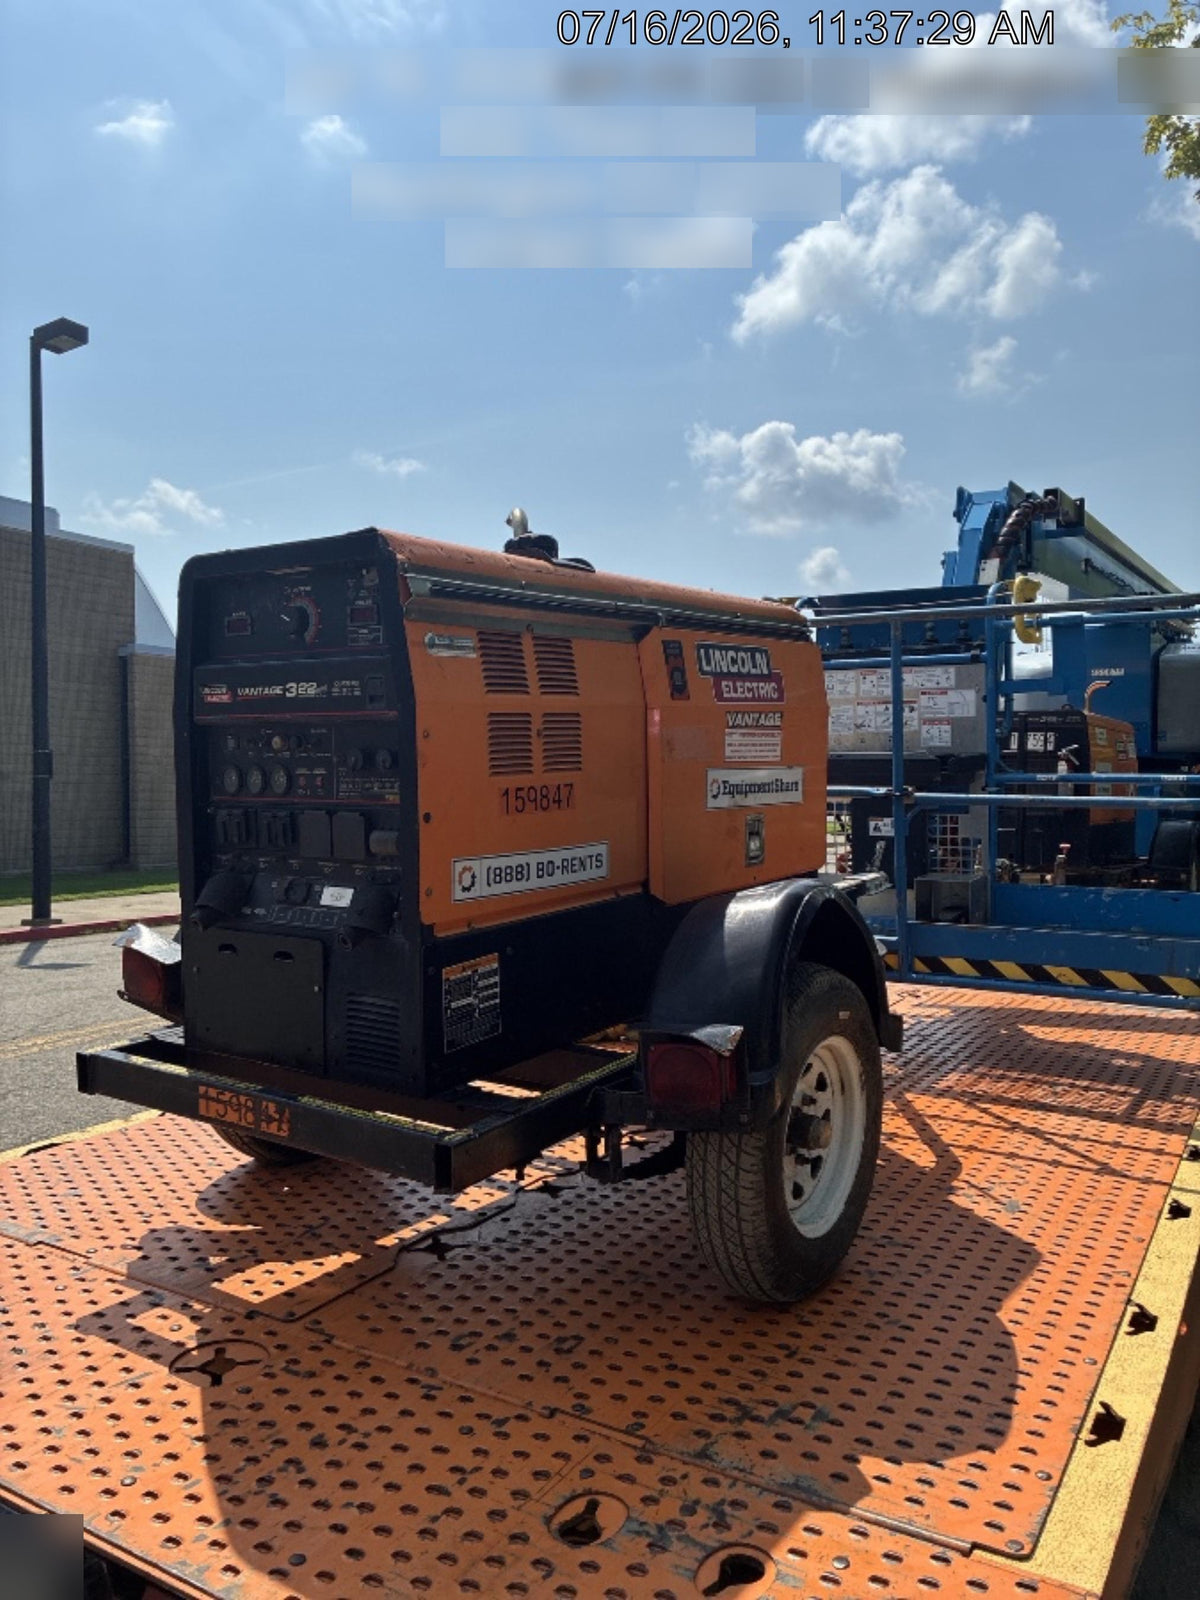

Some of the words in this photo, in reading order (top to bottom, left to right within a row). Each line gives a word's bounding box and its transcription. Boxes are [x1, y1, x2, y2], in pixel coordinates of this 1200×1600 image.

[700, 649, 769, 675] LINCOLN
[237, 686, 284, 696] VANTAGE
[286, 682, 317, 698] 322
[721, 681, 779, 699] ELECTRIC
[726, 712, 782, 727] VANTAGE
[502, 783, 574, 815] 159847
[721, 780, 800, 799] EquipmentShare
[486, 863, 531, 887] (888)
